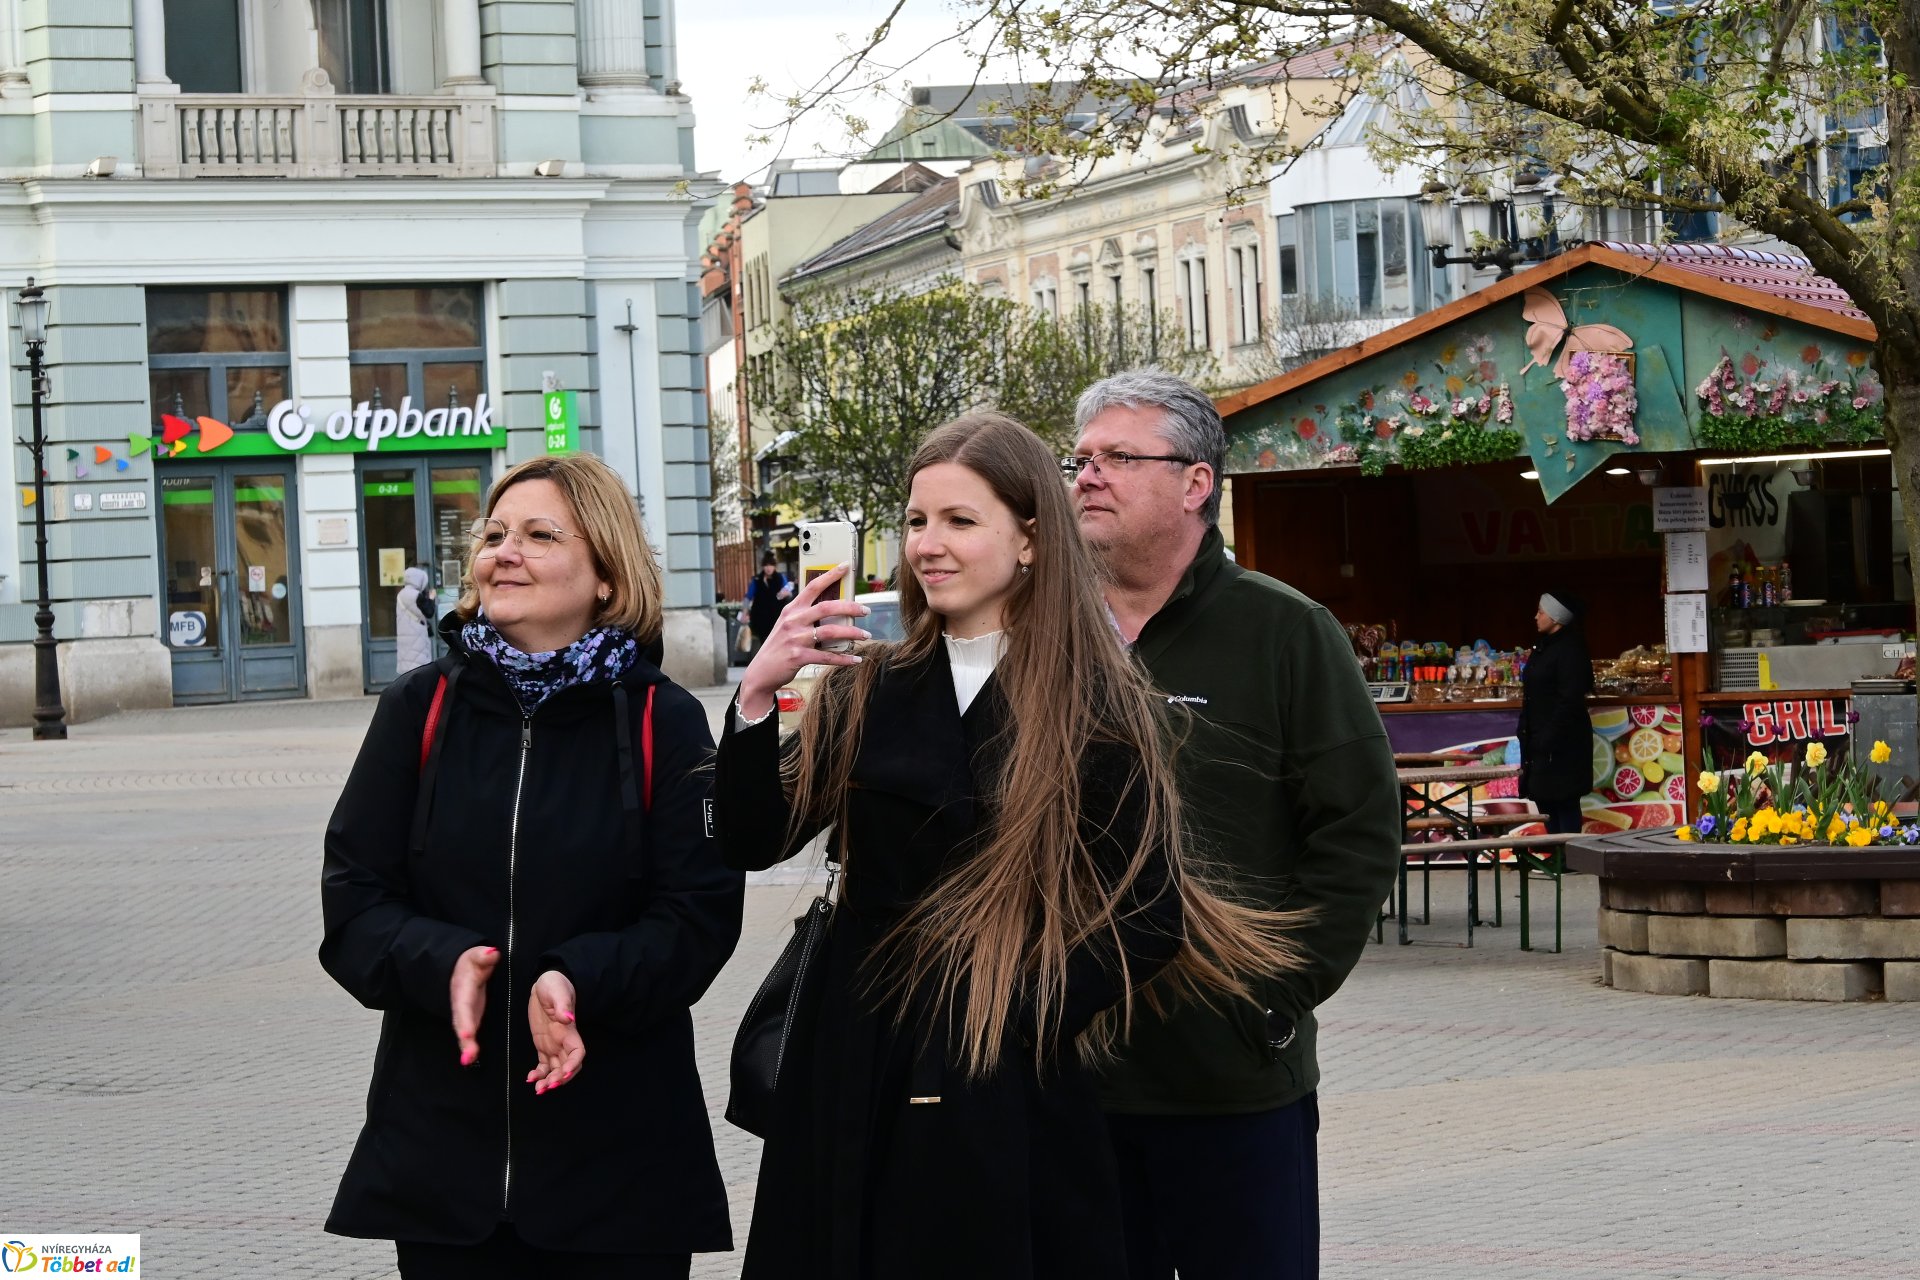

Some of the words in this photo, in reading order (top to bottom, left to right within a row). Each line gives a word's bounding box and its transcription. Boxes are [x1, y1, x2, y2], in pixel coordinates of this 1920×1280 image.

[326, 393, 494, 451] otpbank
[548, 434, 566, 449] 0-24
[378, 484, 398, 494] 0-24
[1708, 473, 1778, 528] GYROS
[170, 620, 196, 632] MFB
[1174, 695, 1208, 704] Columbia
[1743, 699, 1851, 747] GRIL
